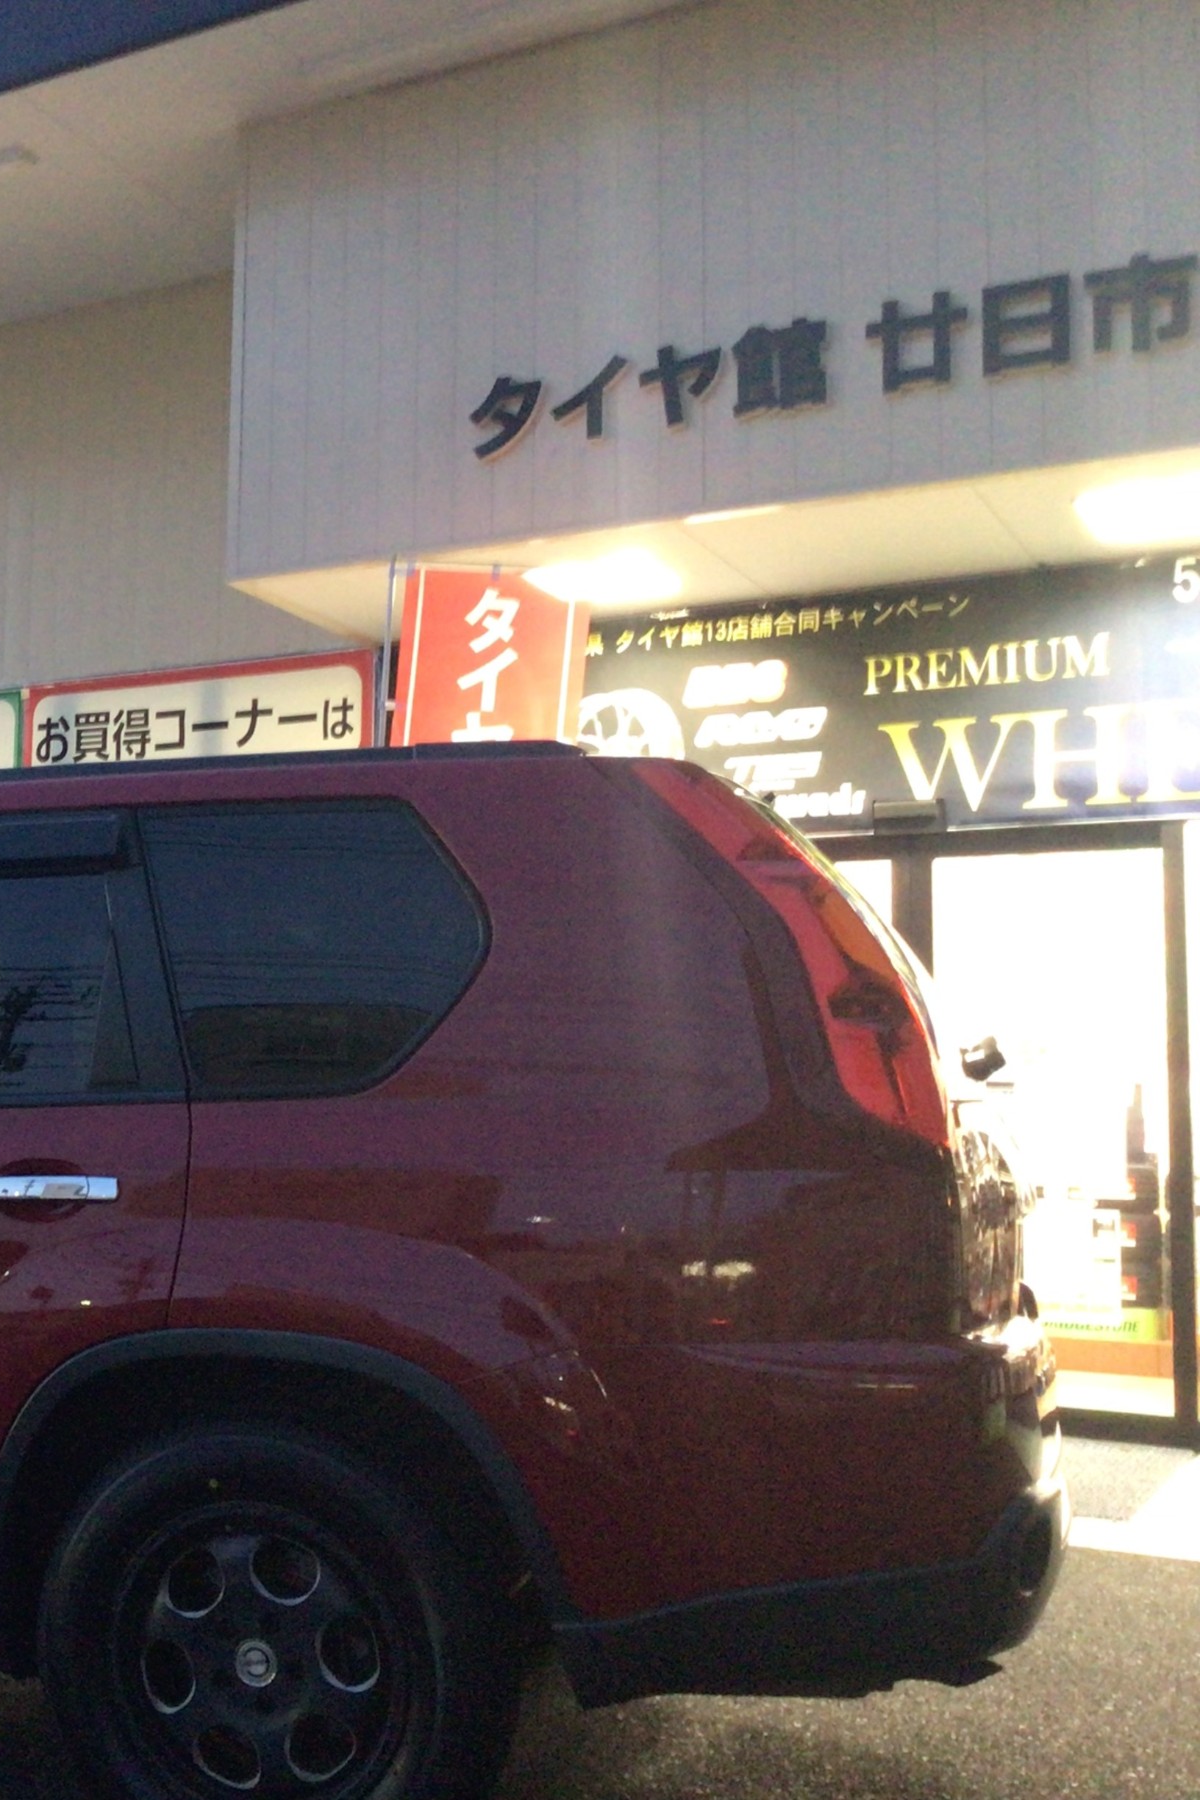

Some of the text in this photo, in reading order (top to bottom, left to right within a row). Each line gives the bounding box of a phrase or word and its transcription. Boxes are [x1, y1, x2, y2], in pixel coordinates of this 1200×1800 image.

[470, 317, 828, 461] タイヤ館
[863, 631, 1111, 696] PREMIUM
[35, 697, 355, 764] お買得コーナーは
